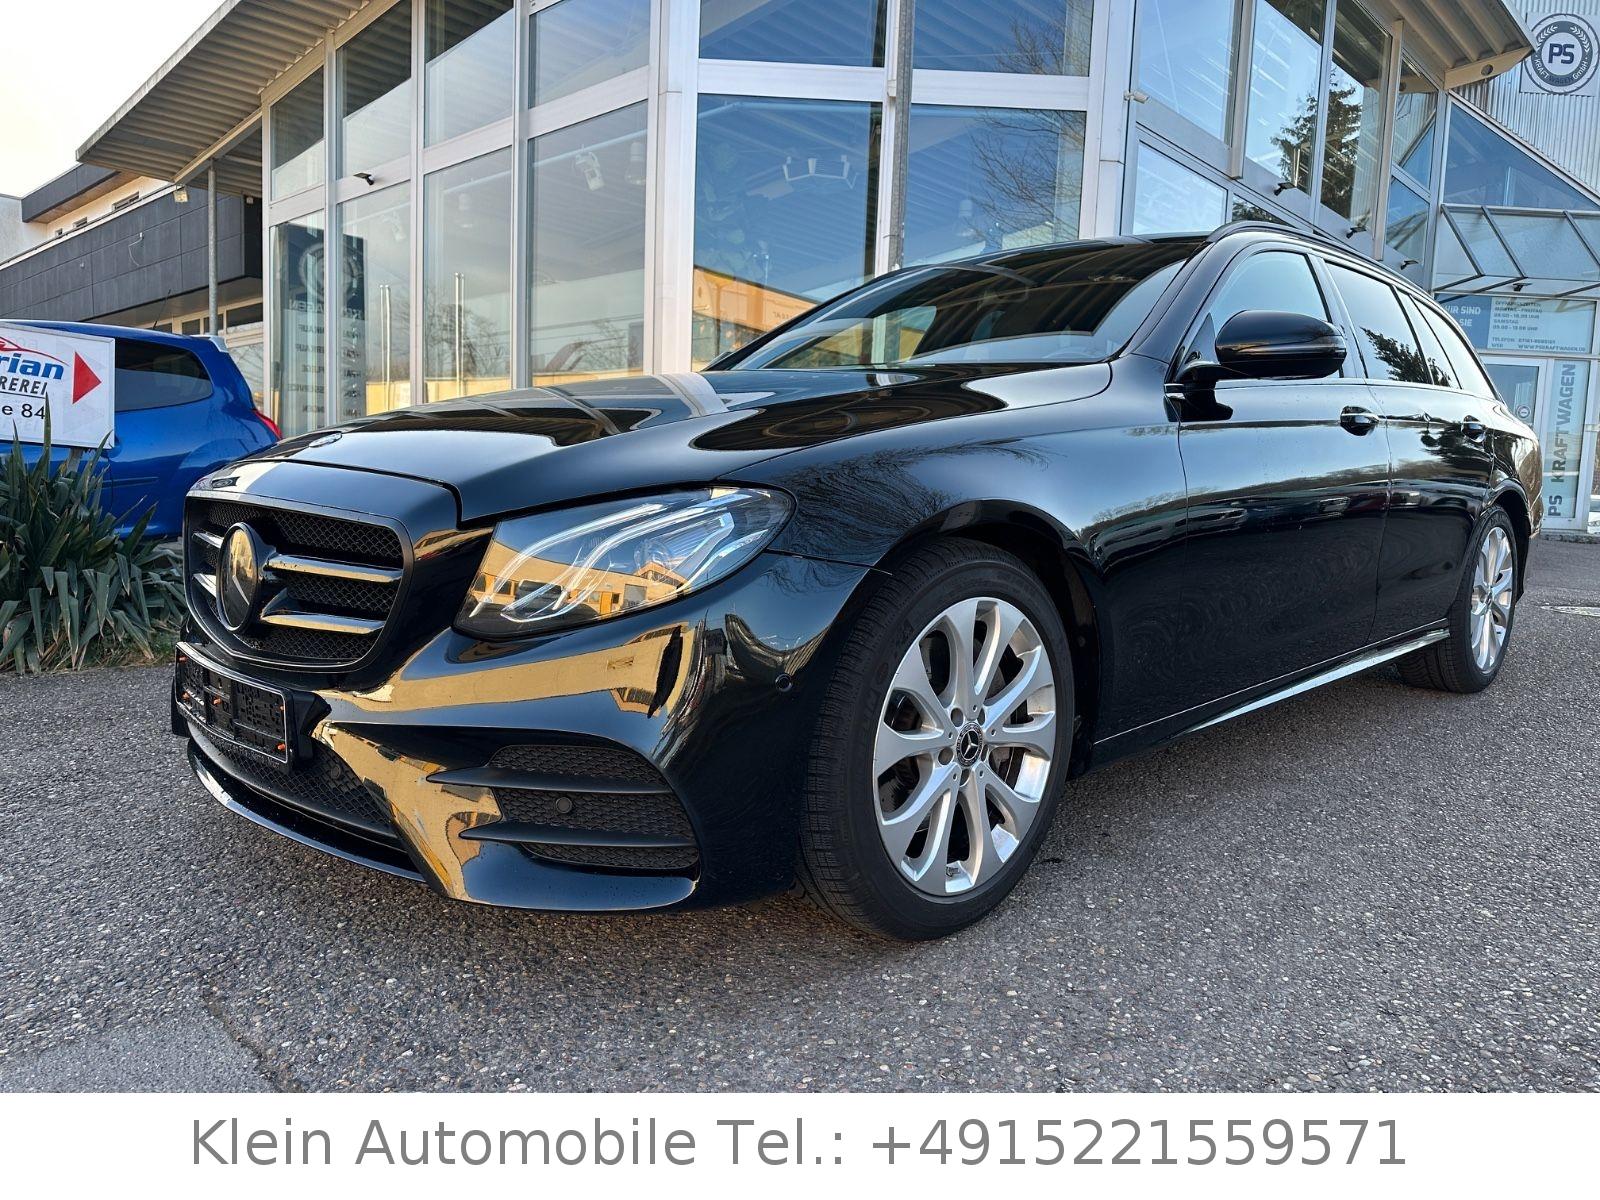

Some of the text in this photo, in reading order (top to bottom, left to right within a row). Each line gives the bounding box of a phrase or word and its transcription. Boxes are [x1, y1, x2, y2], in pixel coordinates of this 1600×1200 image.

[1548, 43, 1575, 64] PS
[1461, 305, 1481, 315] SIND
[1459, 318, 1473, 327] SIE
[0, 376, 48, 395] REREI
[2, 403, 46, 419] e 84
[1548, 364, 1576, 516] PS KRAFTWAGEN
